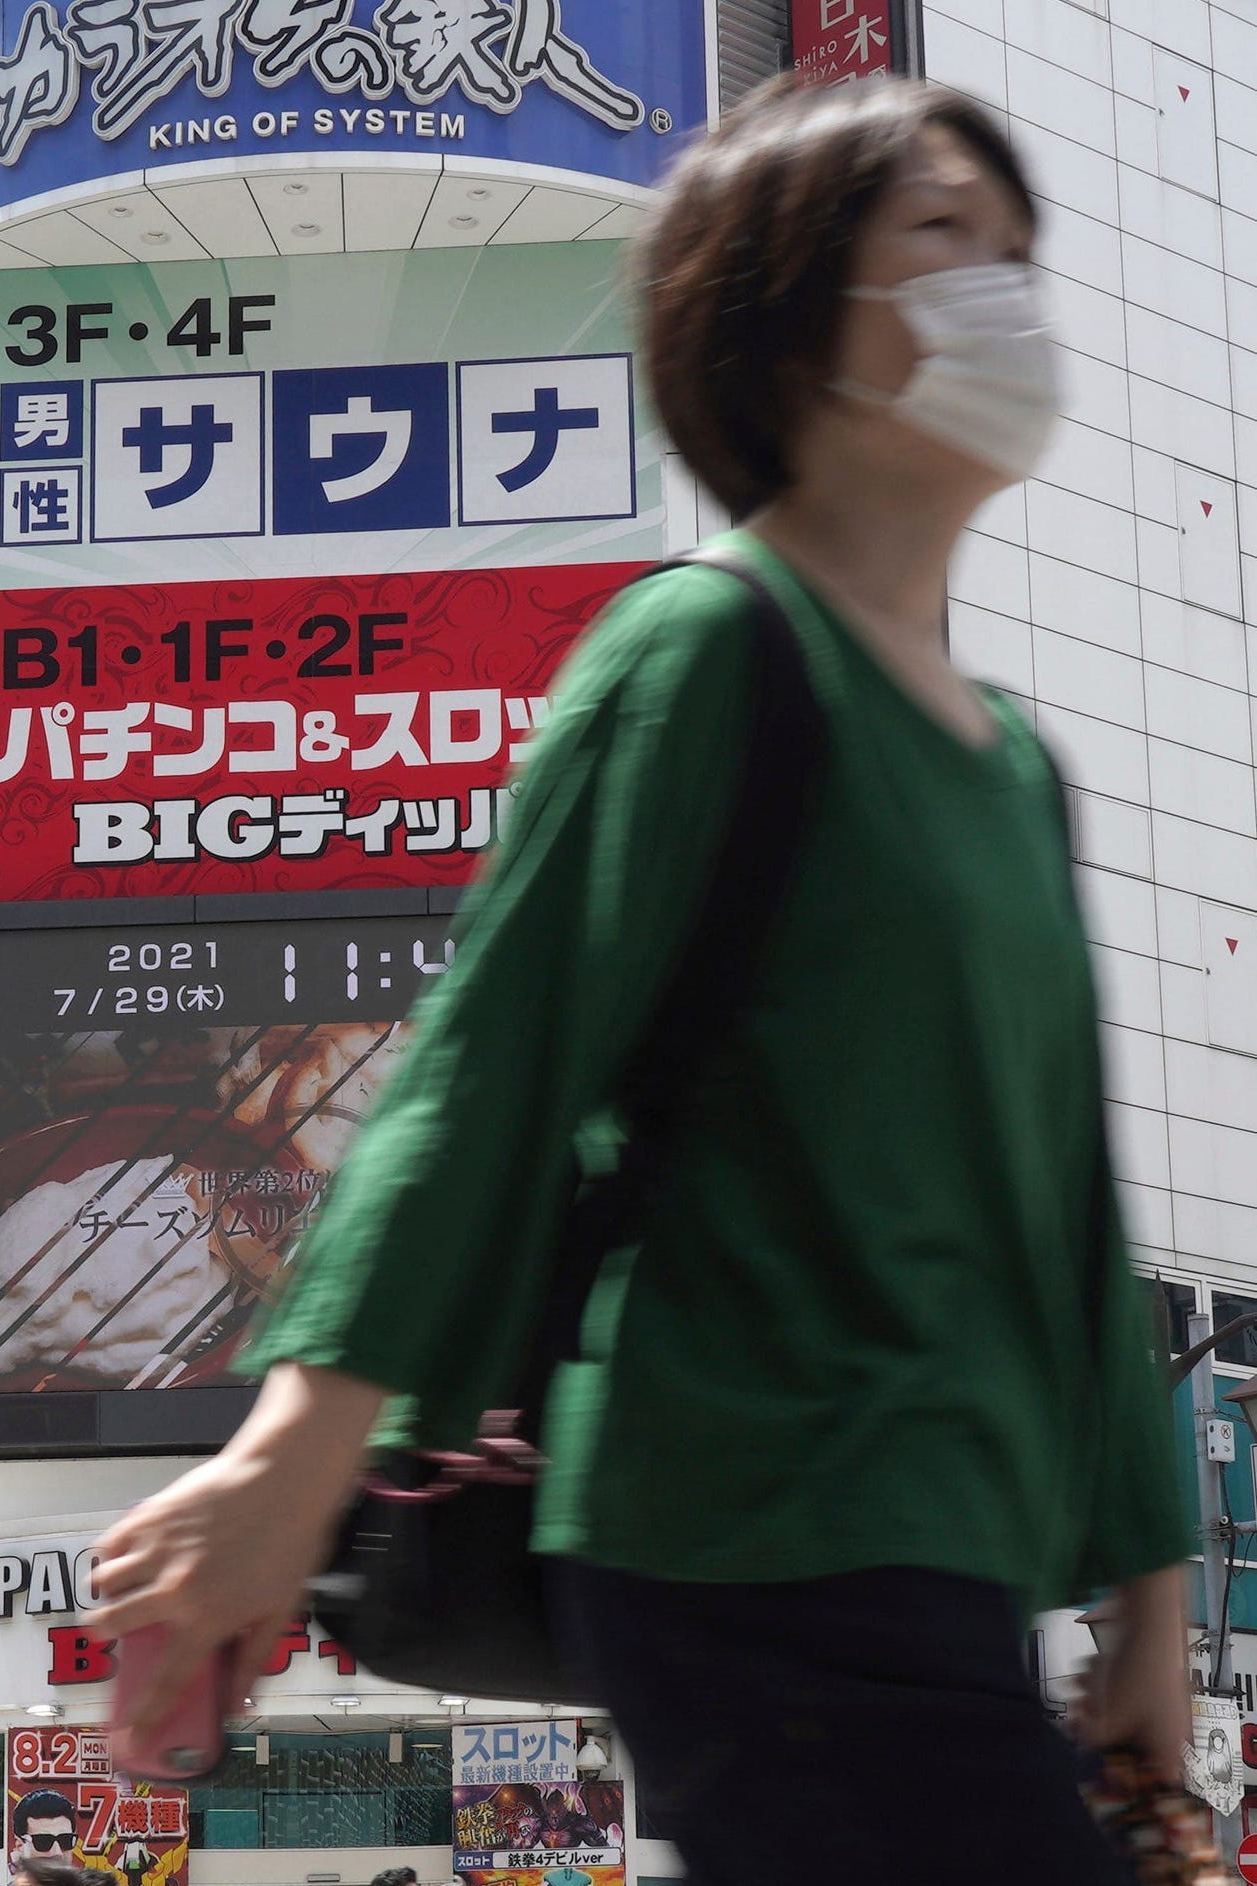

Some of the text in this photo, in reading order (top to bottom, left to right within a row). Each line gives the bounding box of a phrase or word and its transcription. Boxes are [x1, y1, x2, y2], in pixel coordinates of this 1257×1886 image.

[820, 0, 888, 88] 白木
[149, 108, 466, 149] KING OF SYSTEM
[13, 393, 70, 534] 男性
[122, 387, 600, 510] サウナ
[108, 942, 219, 972] 2021
[13, 1732, 78, 1778] 8.2
[83, 1743, 107, 1754] MON
[460, 1722, 571, 1764] スロット
[458, 1855, 491, 1867] スロット
